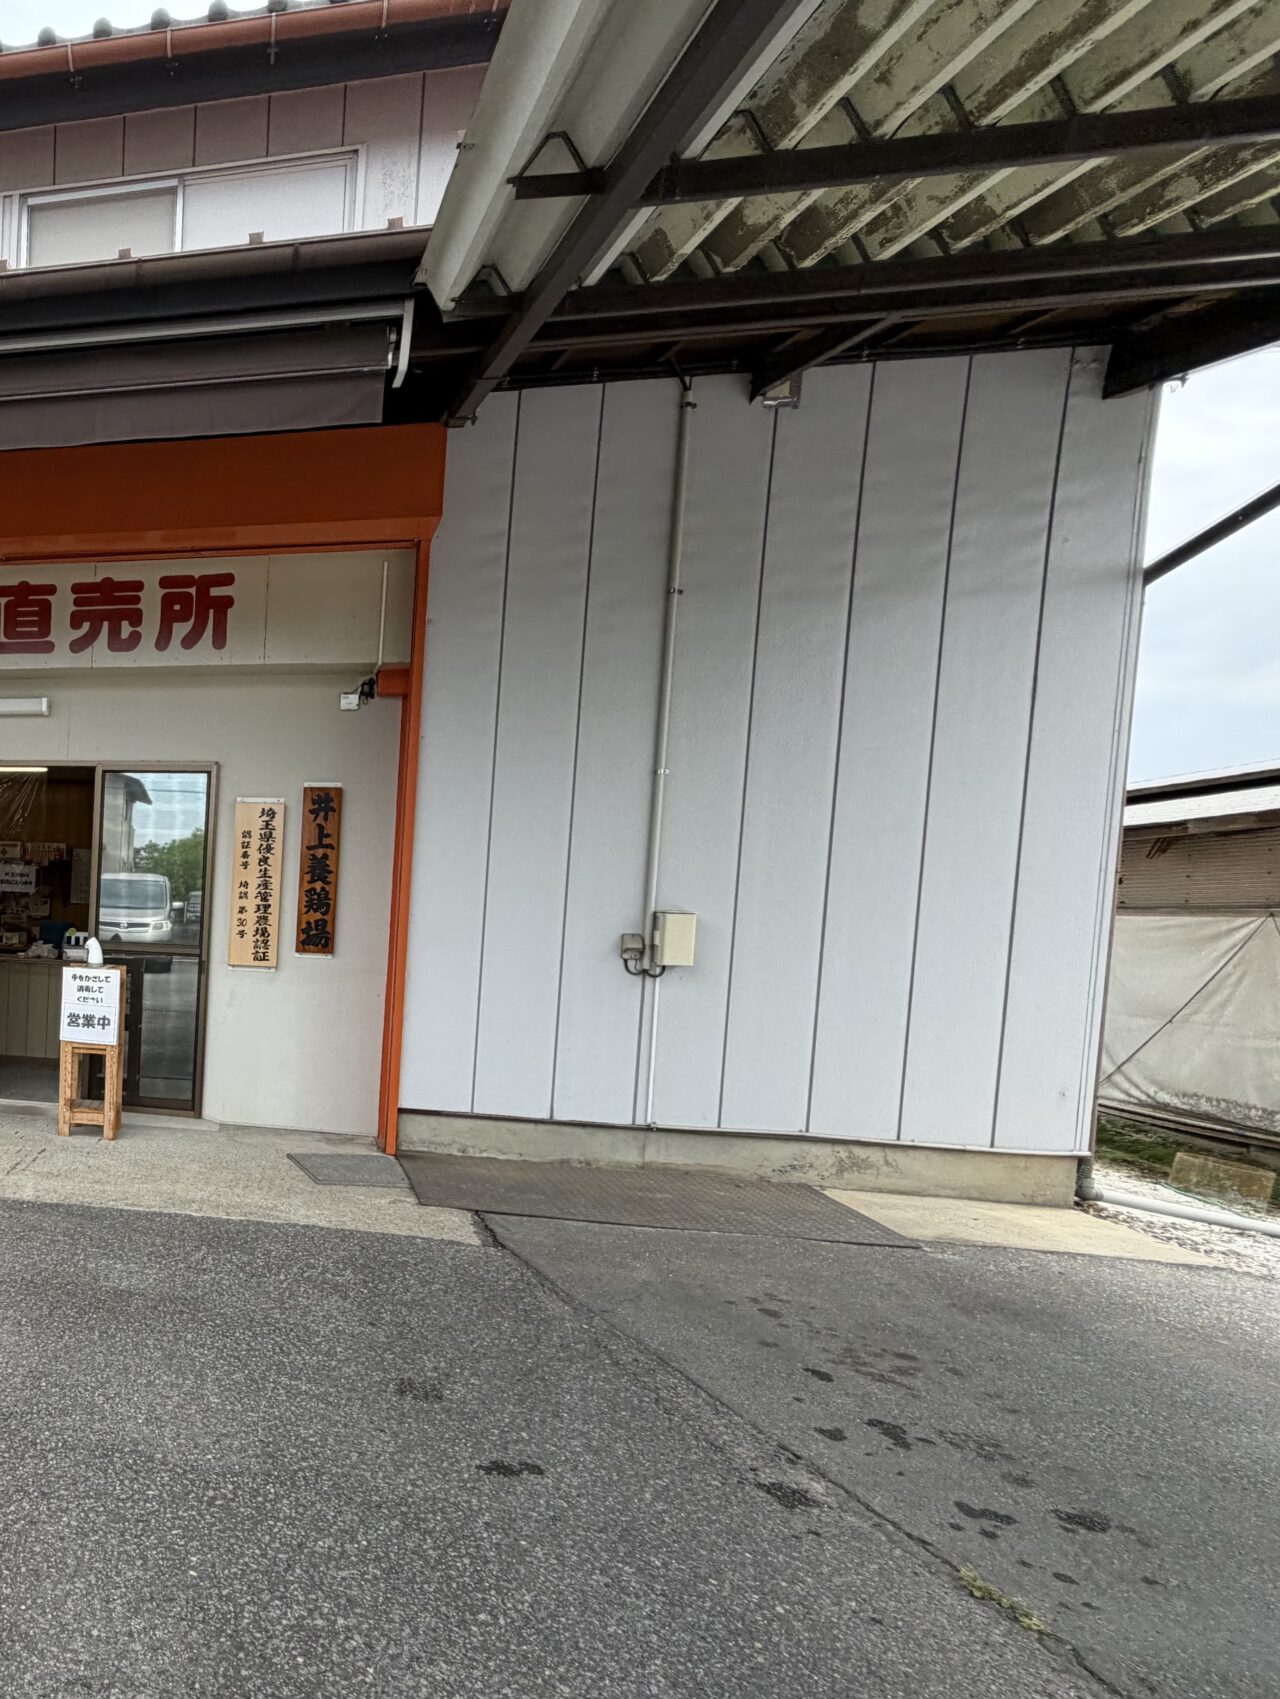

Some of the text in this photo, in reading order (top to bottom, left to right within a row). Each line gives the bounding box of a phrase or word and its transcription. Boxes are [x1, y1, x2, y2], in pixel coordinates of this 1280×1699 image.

[251, 807, 277, 962] 埼玉県優良生産管理農場認証
[300, 791, 337, 949] 井上養鶏場
[67, 1012, 111, 1031] 営業中
